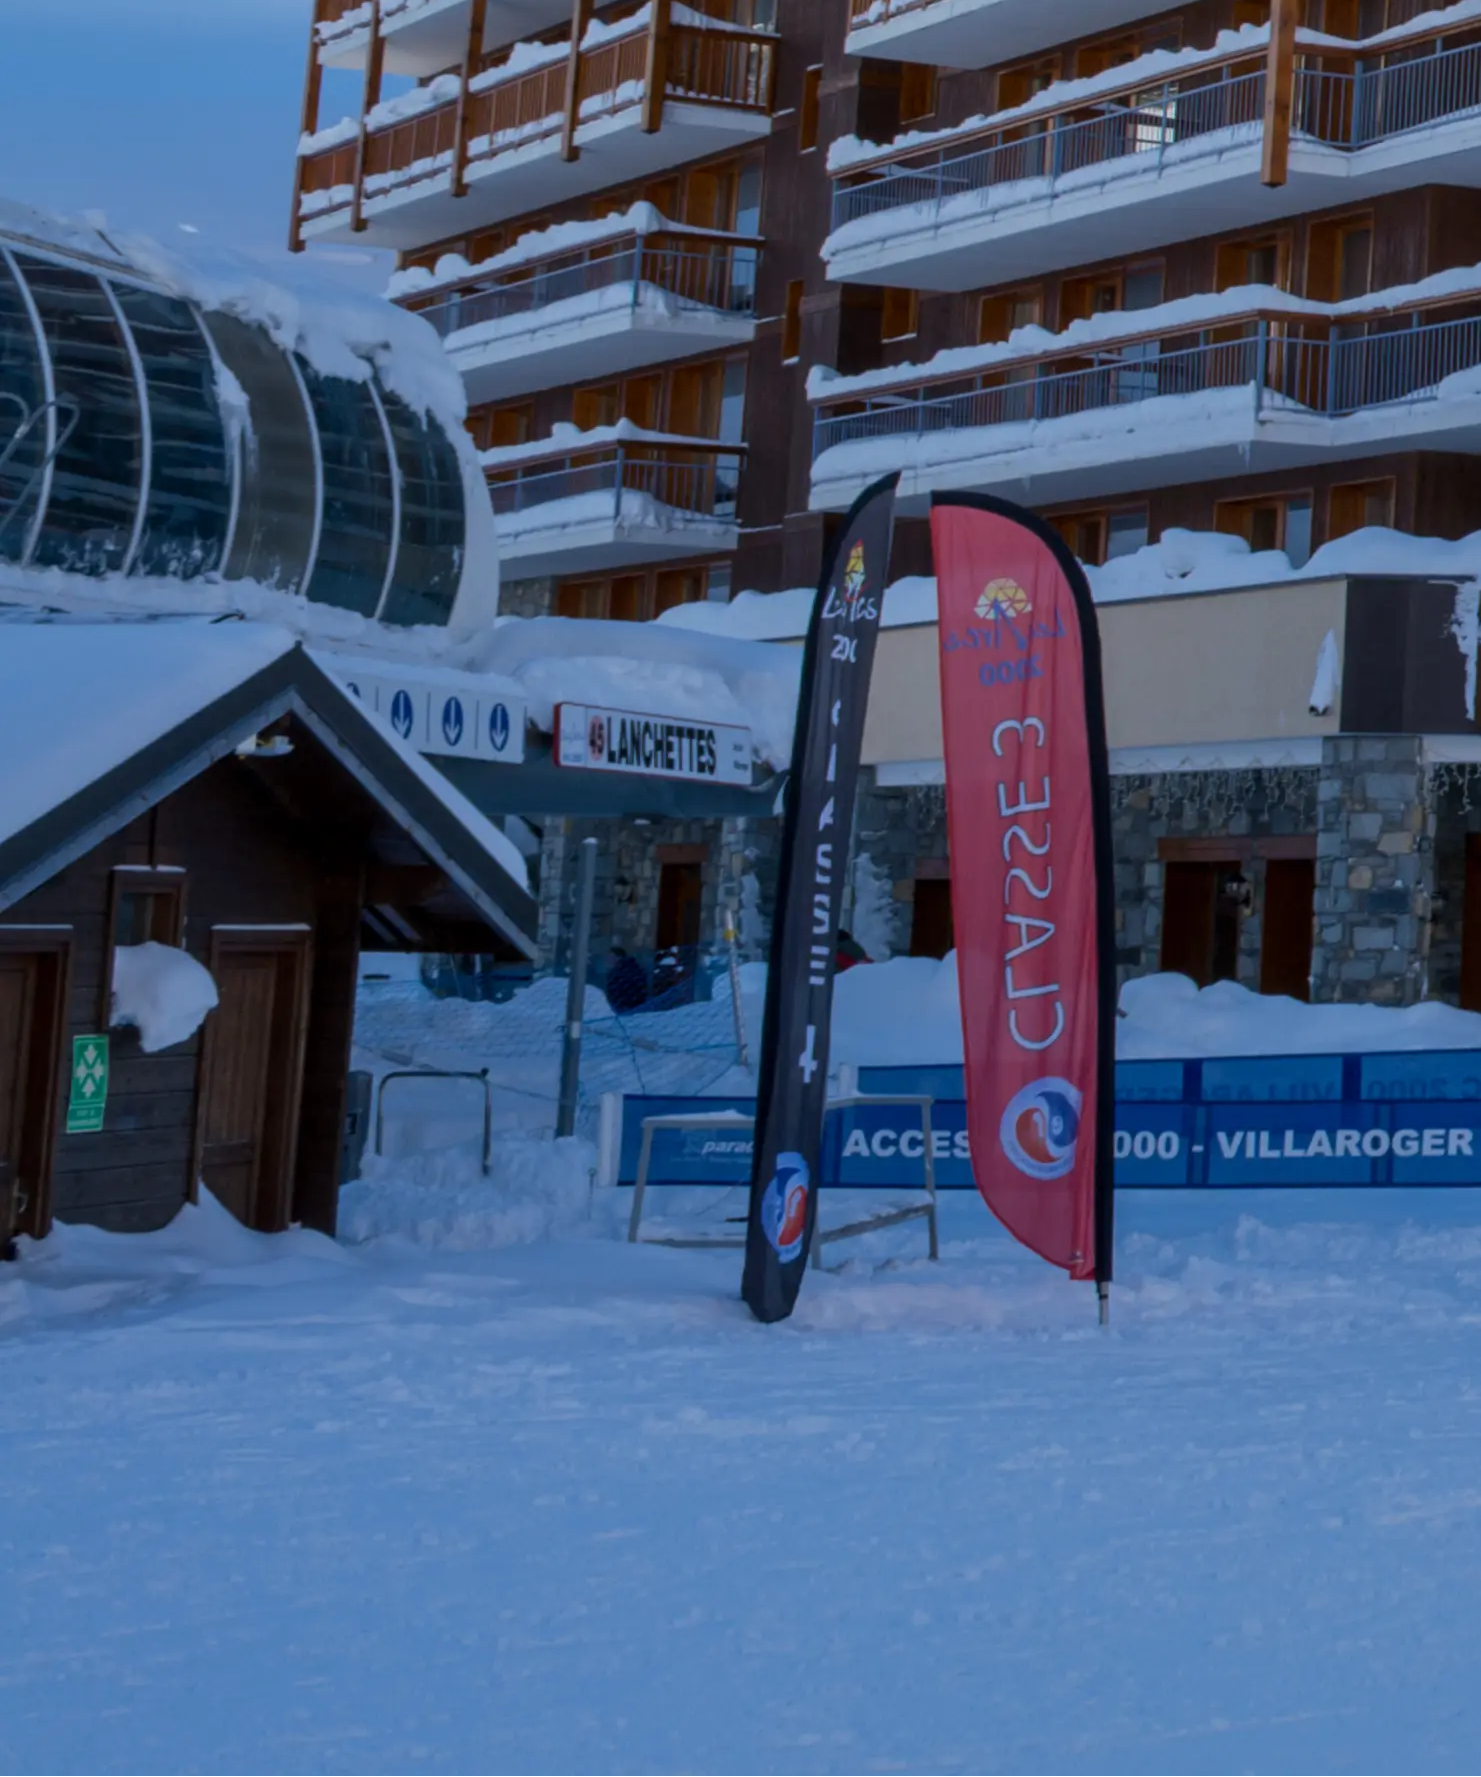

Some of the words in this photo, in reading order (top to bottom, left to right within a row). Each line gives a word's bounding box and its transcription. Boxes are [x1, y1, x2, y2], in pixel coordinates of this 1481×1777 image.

[606, 716, 717, 776] LANCHETTES
[842, 1128, 969, 1159] ACCES
[1113, 1130, 1179, 1159] 000
[1216, 1128, 1474, 1159] VILLAROGER
